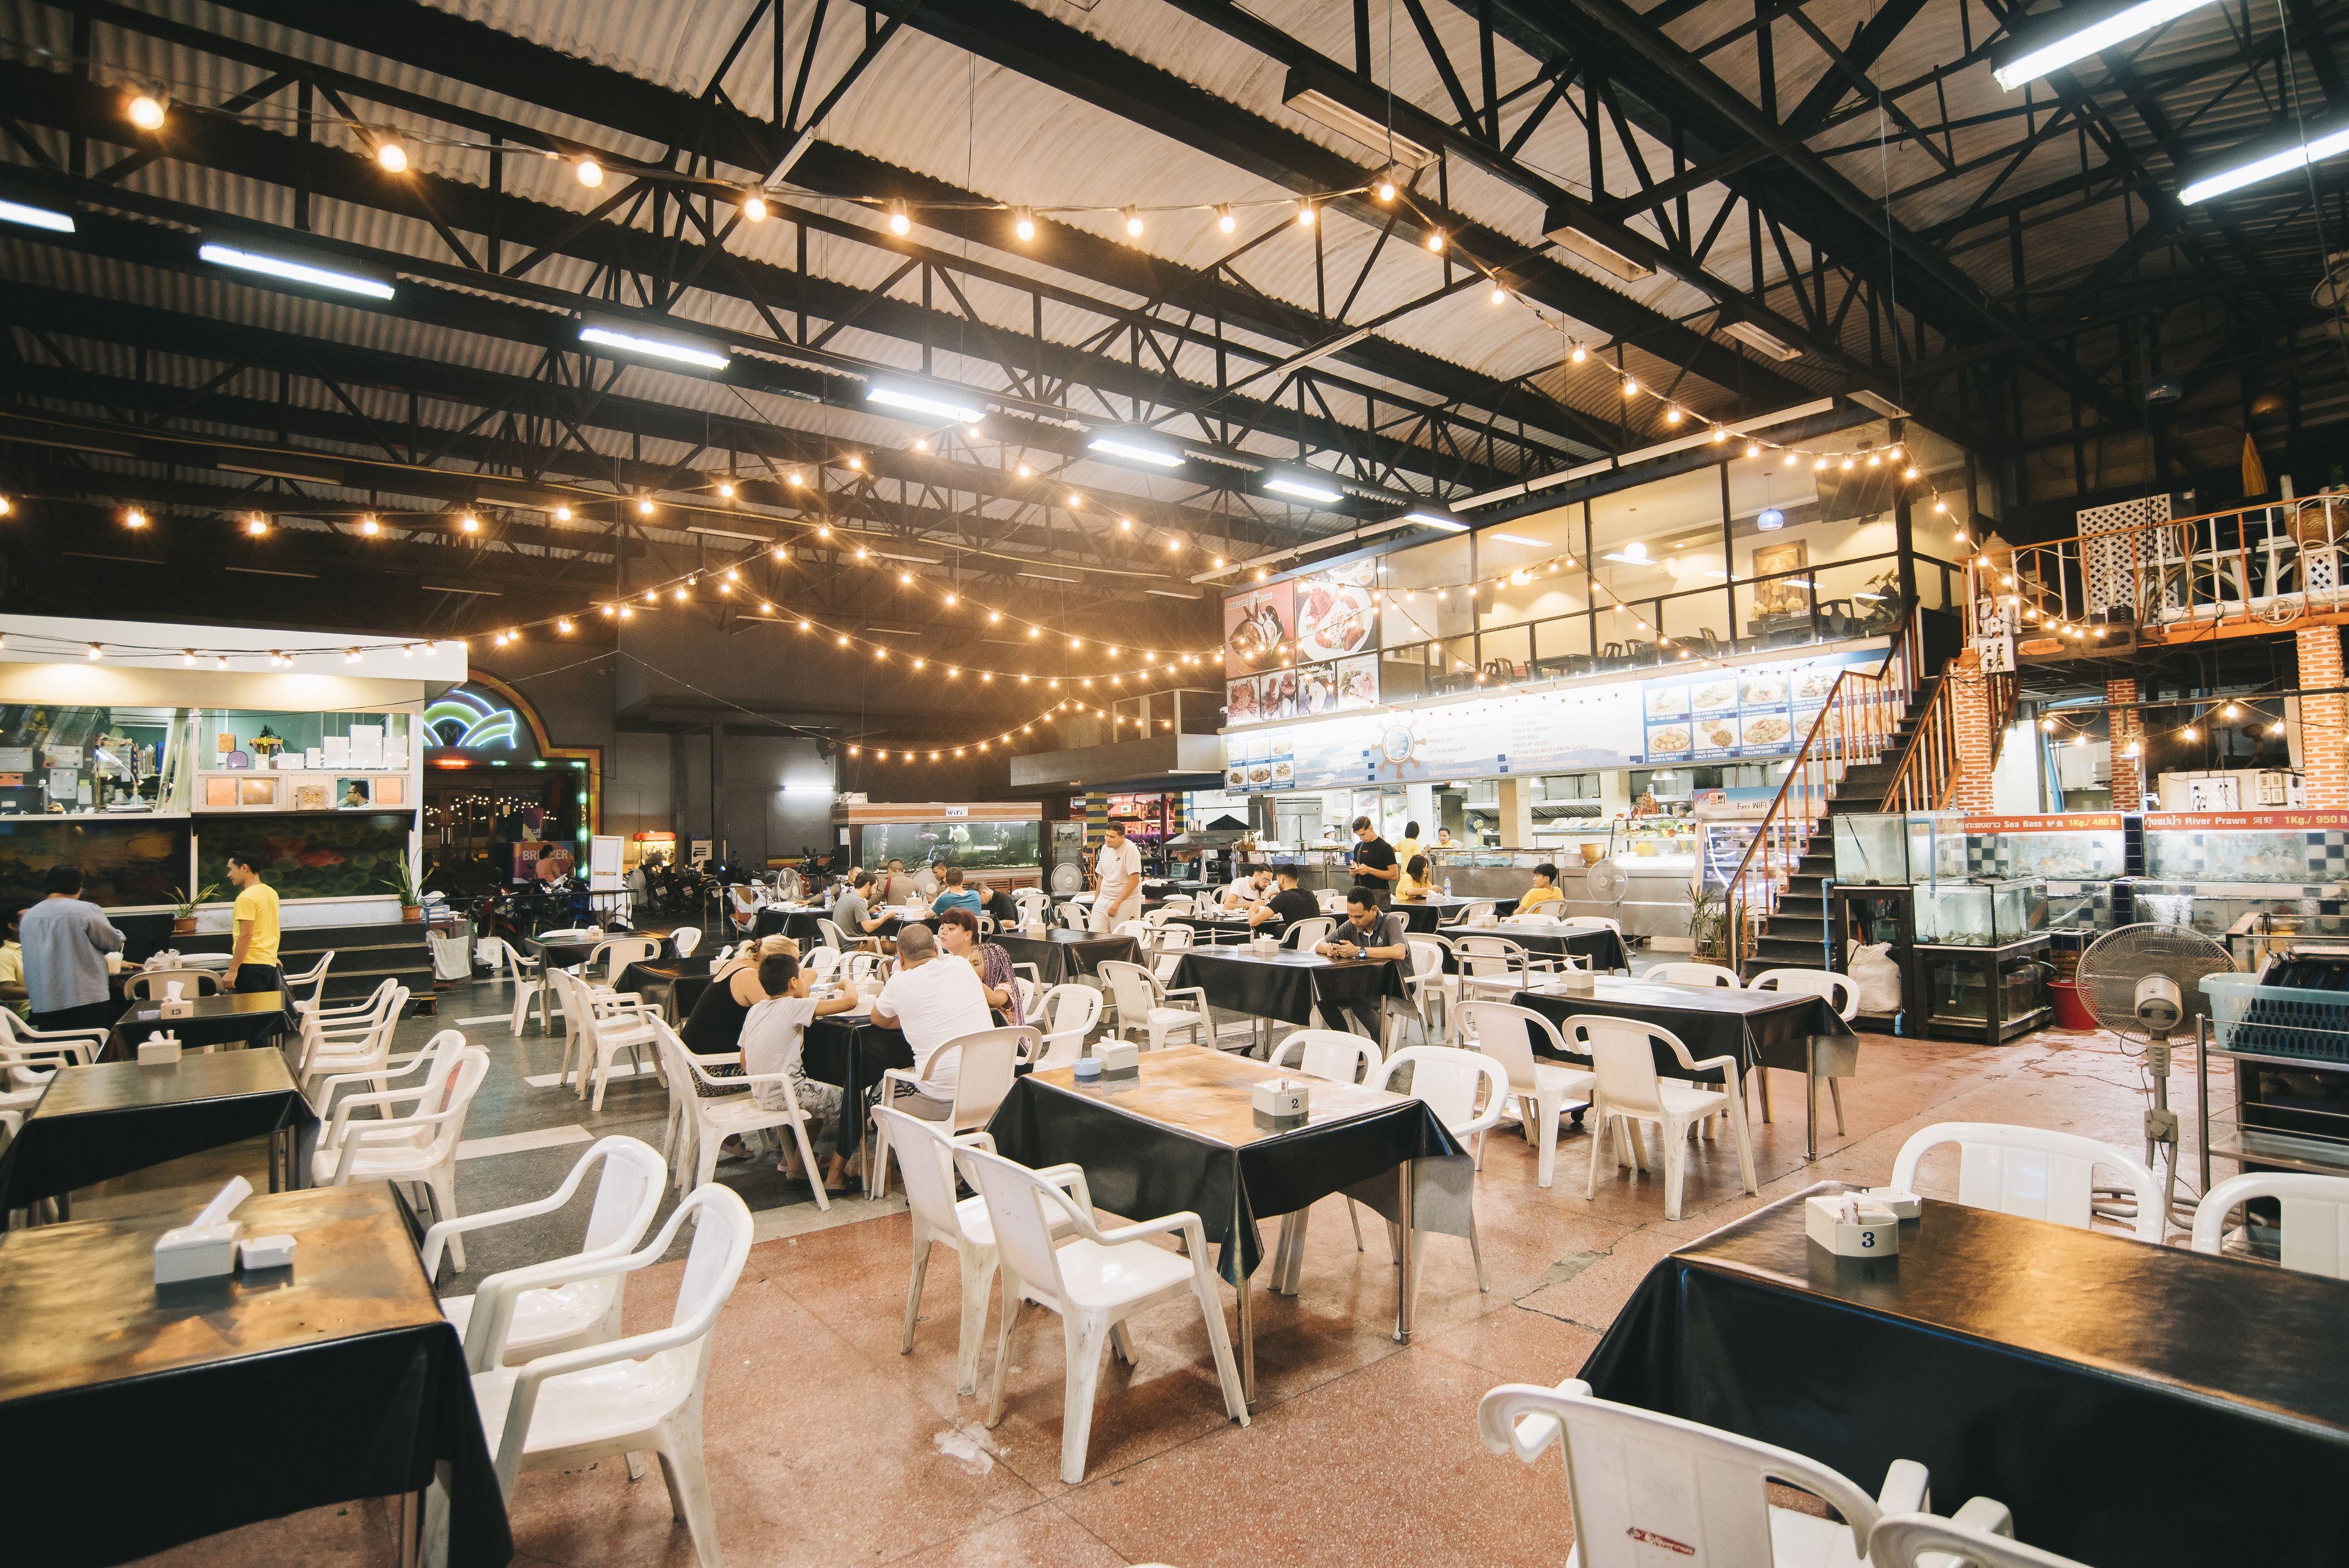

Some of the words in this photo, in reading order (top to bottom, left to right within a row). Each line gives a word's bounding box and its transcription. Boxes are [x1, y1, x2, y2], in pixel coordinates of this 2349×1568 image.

[444, 726, 459, 738] M
[2185, 817, 2210, 825] River
[2284, 816, 2311, 826] 1Kg./
[2316, 816, 2337, 824] 950
[1291, 1098, 1299, 1109] 2
[1861, 1232, 1875, 1247] 3
